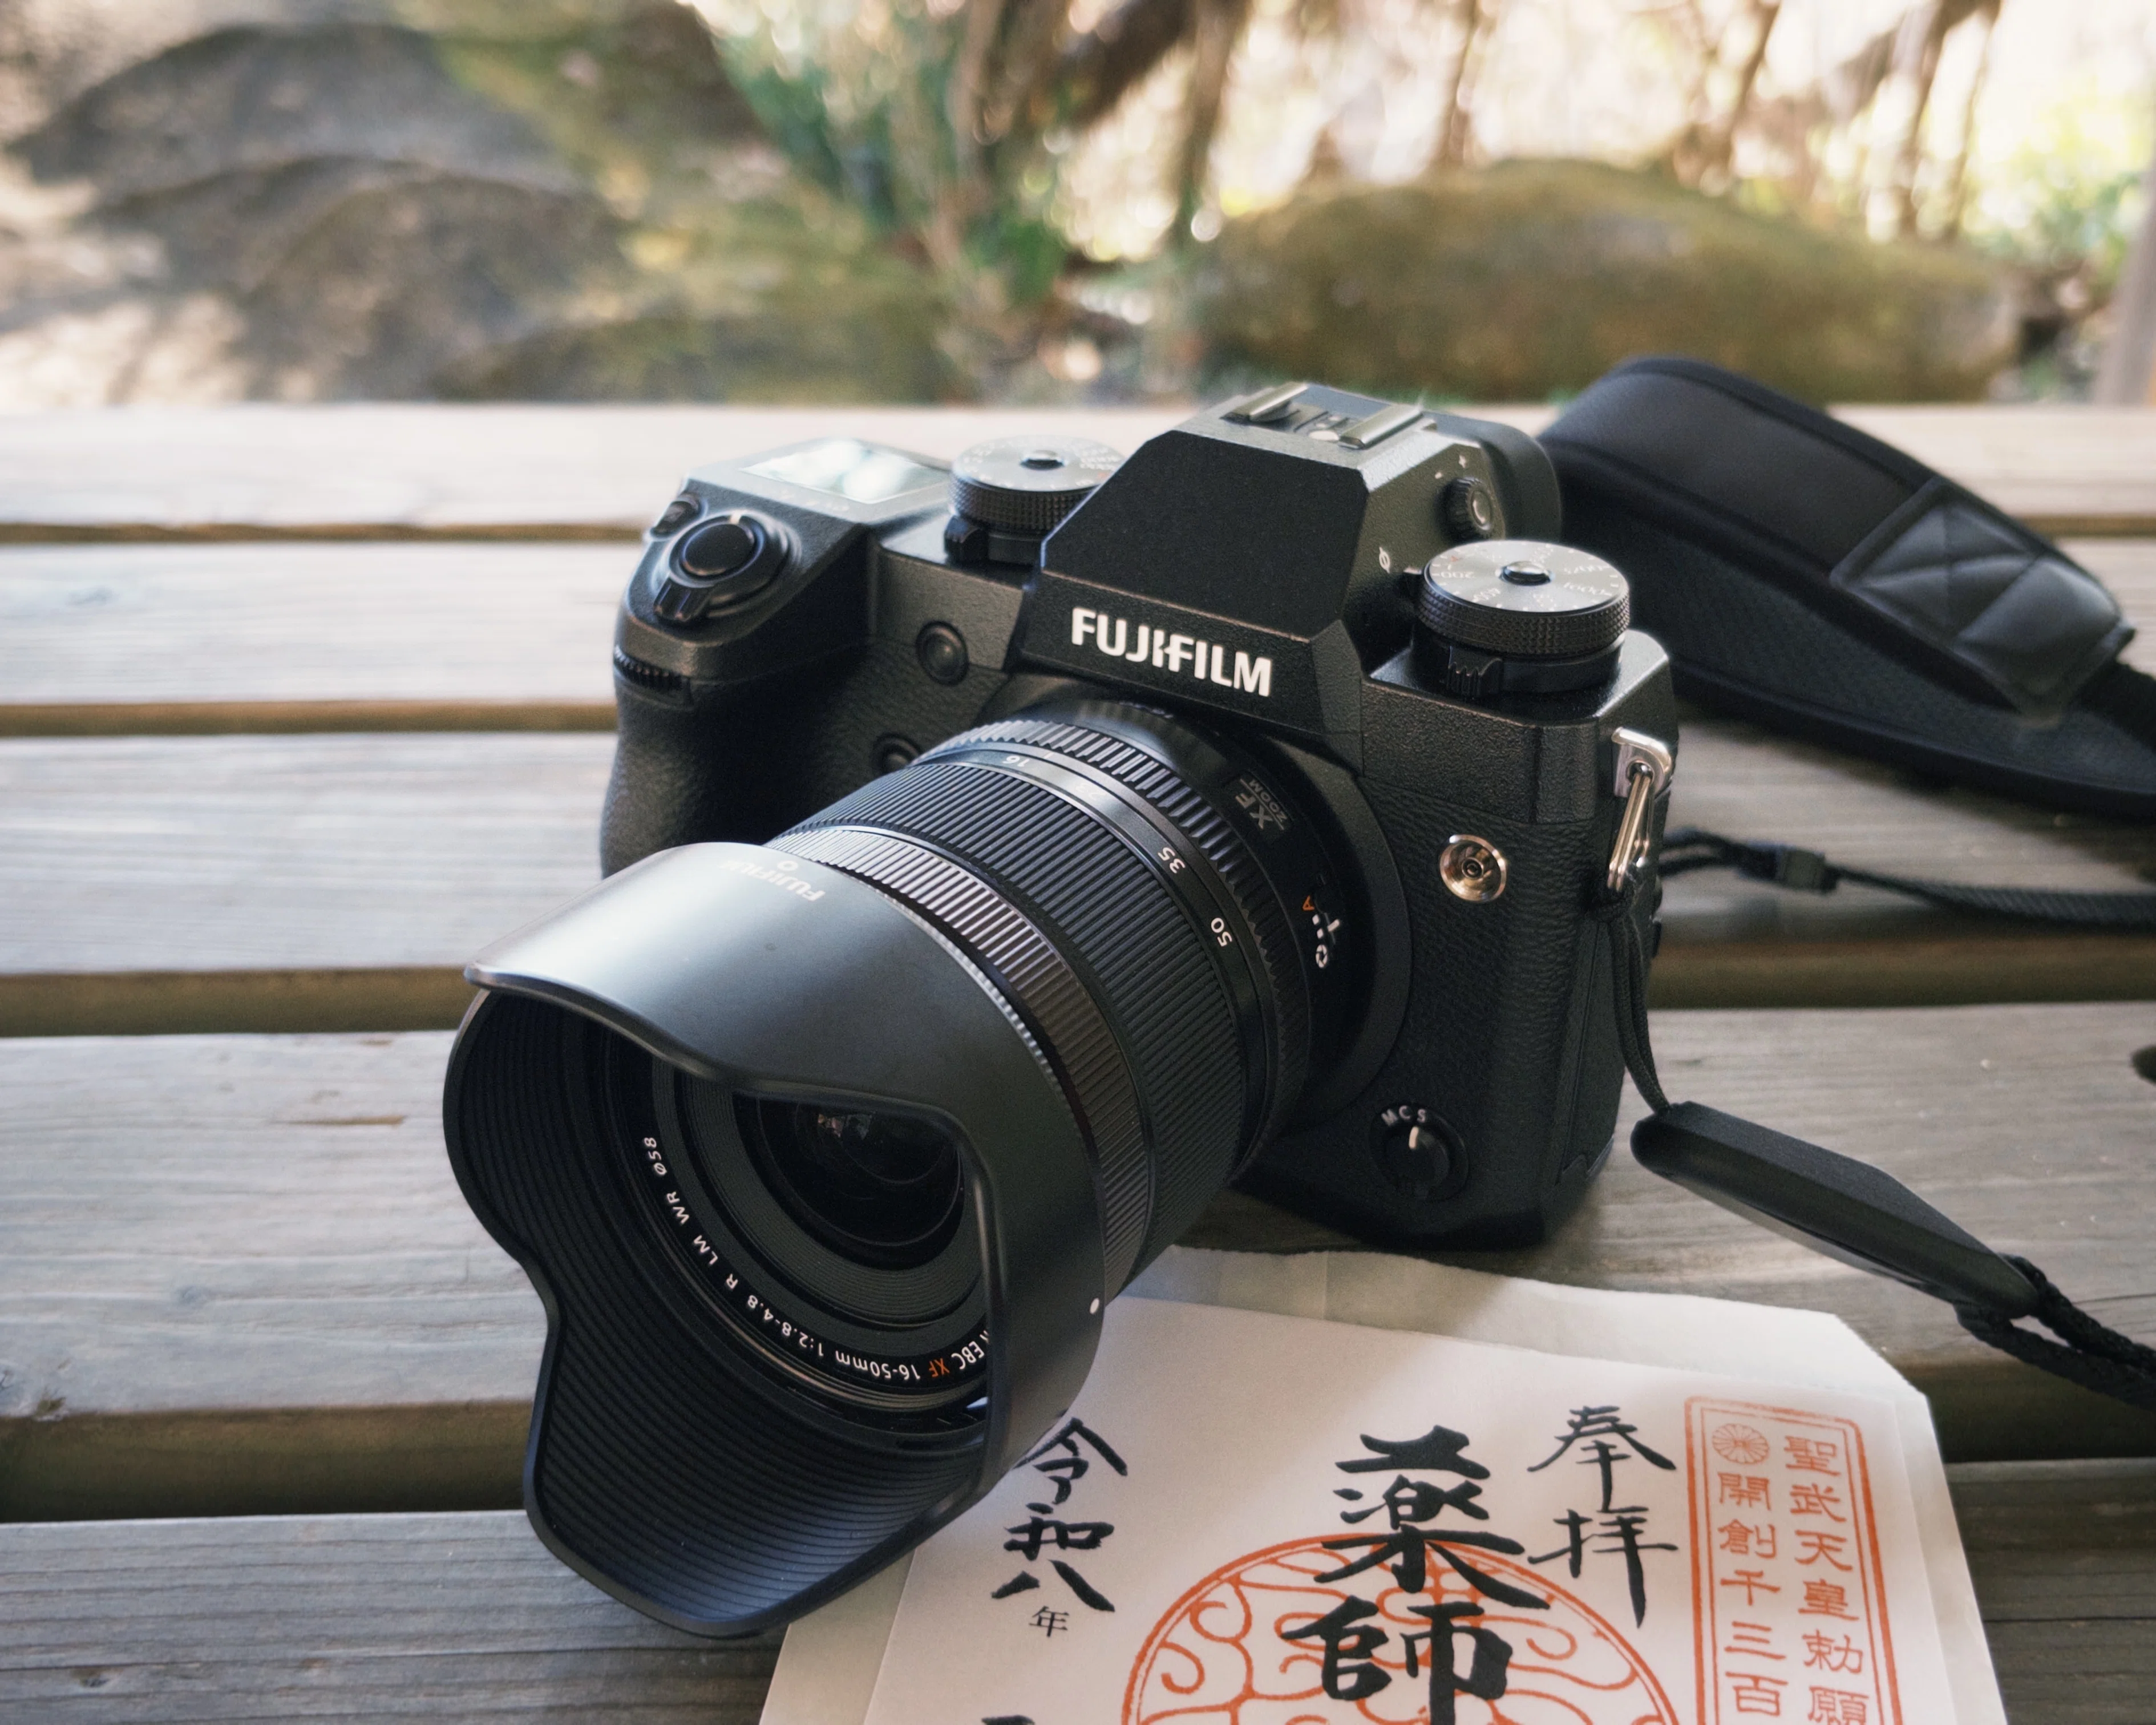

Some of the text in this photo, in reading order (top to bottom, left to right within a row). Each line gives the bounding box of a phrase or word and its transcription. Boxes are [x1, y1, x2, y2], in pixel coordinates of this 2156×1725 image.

[1071, 607, 1272, 697] FUJIFILM
[1002, 755, 1030, 768] 16
[1235, 793, 1274, 830] XF
[1249, 779, 1288, 822] ZOOM
[1157, 846, 1186, 874] 35
[1303, 895, 1315, 911] A
[1211, 918, 1232, 947] 50
[666, 1191, 690, 1225] WR
[693, 1234, 719, 1266] LM
[725, 1273, 739, 1290] R
[747, 1294, 824, 1357] 1:2.8-4.8
[835, 1350, 921, 1380] 16-50mm
[928, 1358, 950, 1377] XF
[950, 1341, 985, 1370] EBC
[1527, 1404, 1678, 1628] 奉拝
